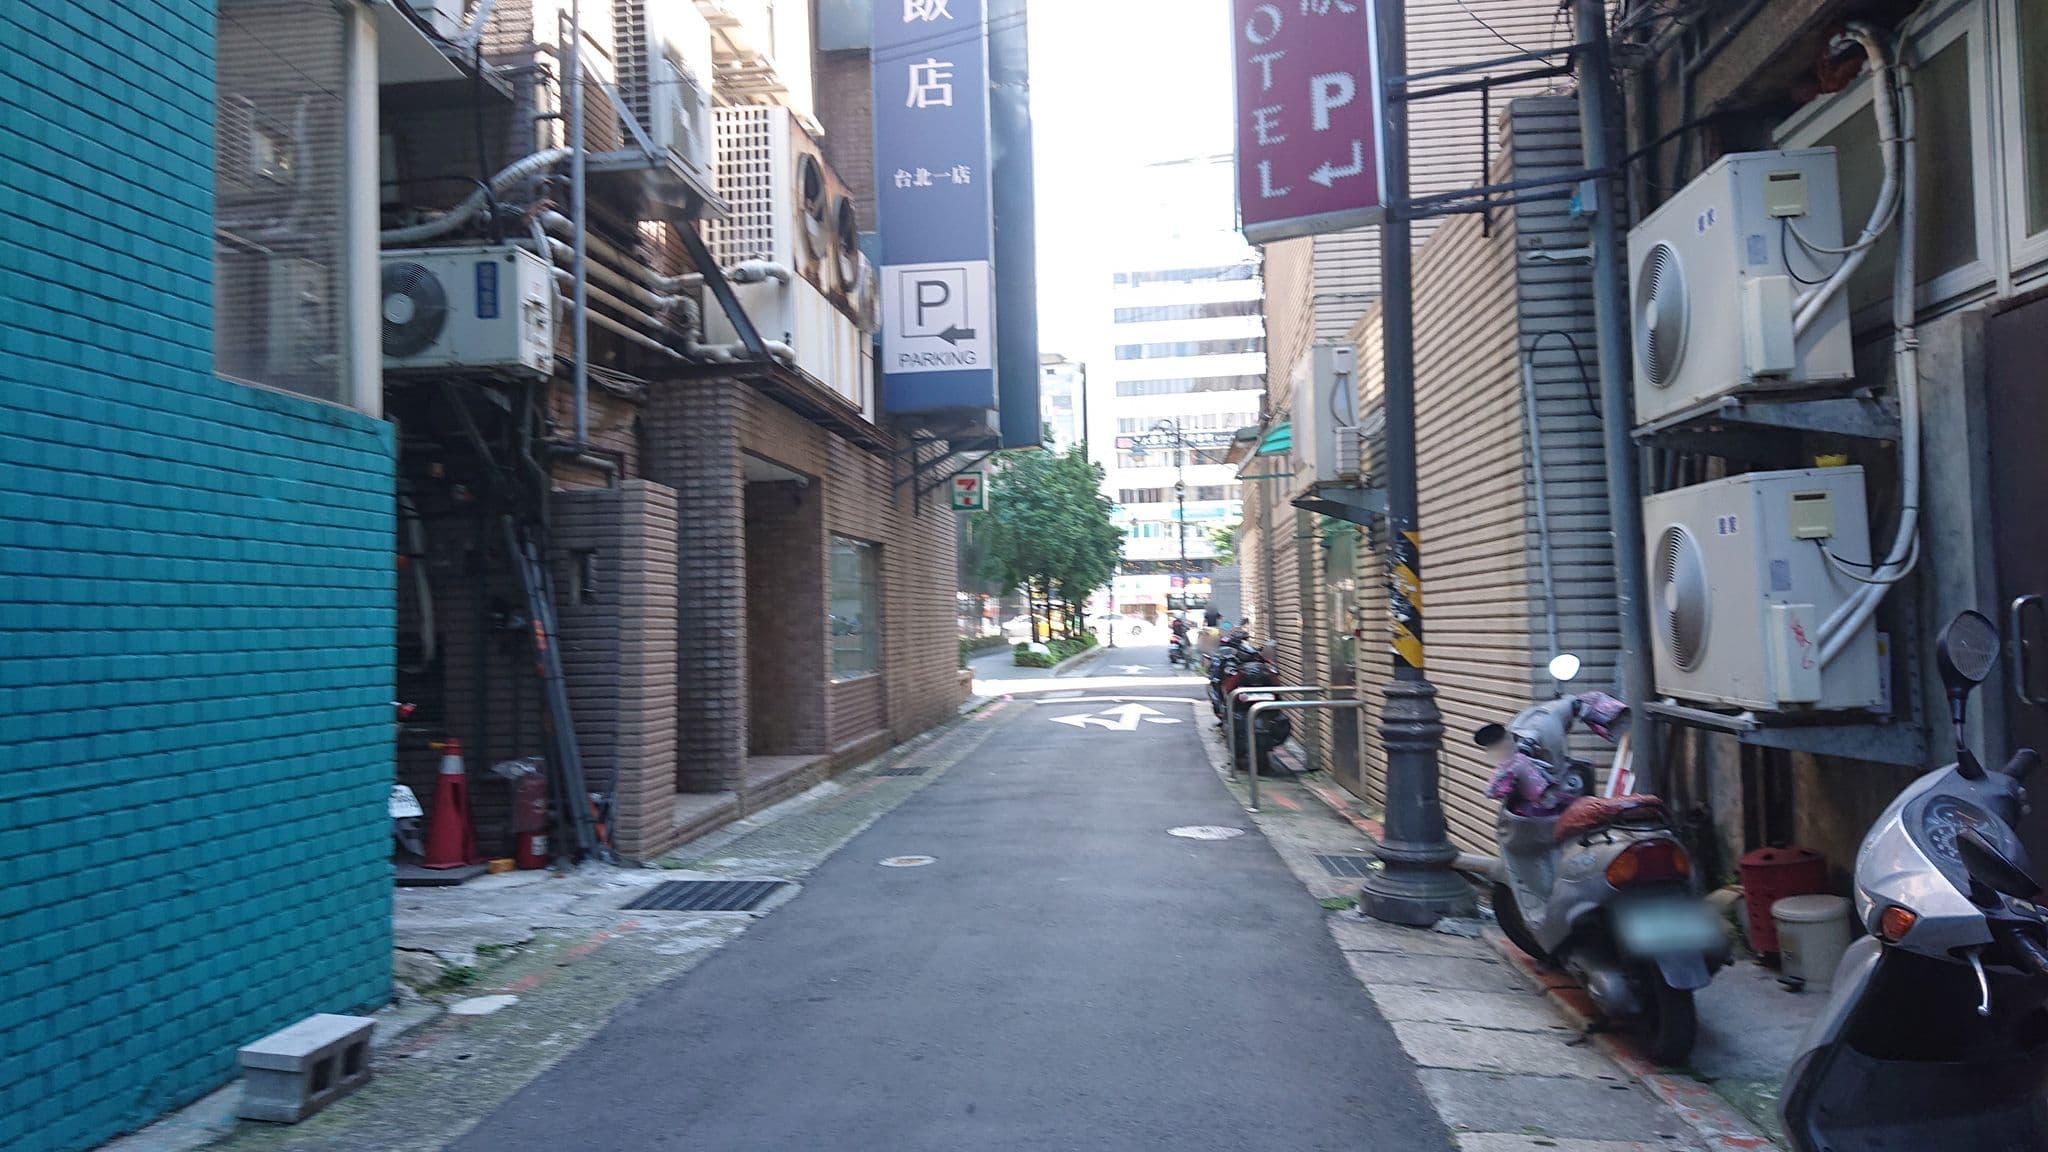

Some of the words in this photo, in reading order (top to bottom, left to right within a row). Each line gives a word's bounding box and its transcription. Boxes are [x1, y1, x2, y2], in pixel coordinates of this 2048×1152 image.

[1245, 3, 1293, 199] OTEL
[1311, 72, 1357, 132] P
[894, 164, 971, 188] 台北一店
[917, 280, 949, 327] P
[899, 350, 976, 367] PARKING
